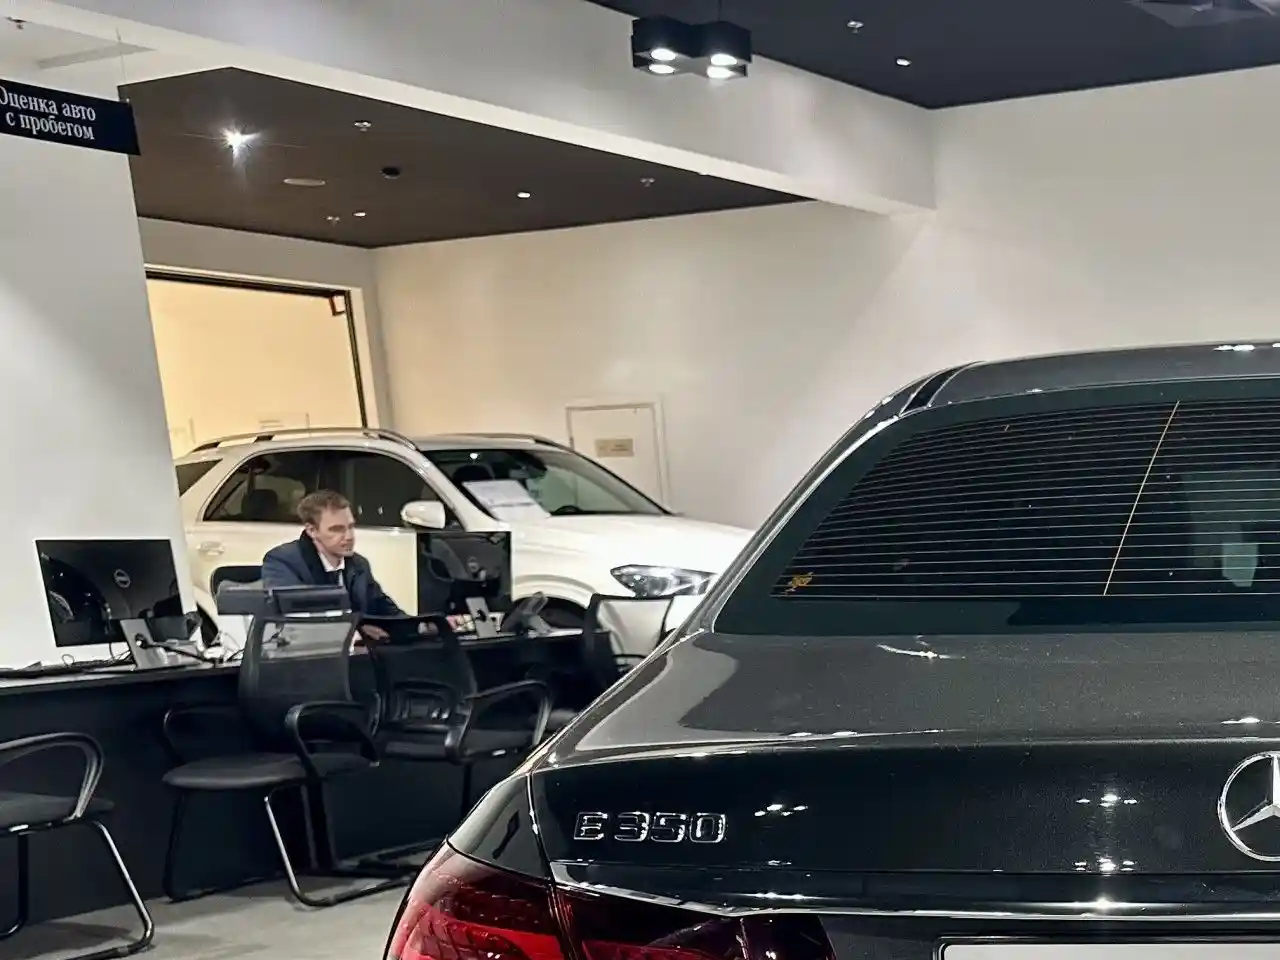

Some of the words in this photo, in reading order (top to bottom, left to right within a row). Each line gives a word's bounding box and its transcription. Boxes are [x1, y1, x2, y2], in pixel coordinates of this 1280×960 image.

[62, 102, 96, 121] авто
[5, 112, 16, 126] с
[18, 114, 95, 140] пробегом
[573, 811, 609, 841] E
[614, 811, 729, 843] 350
